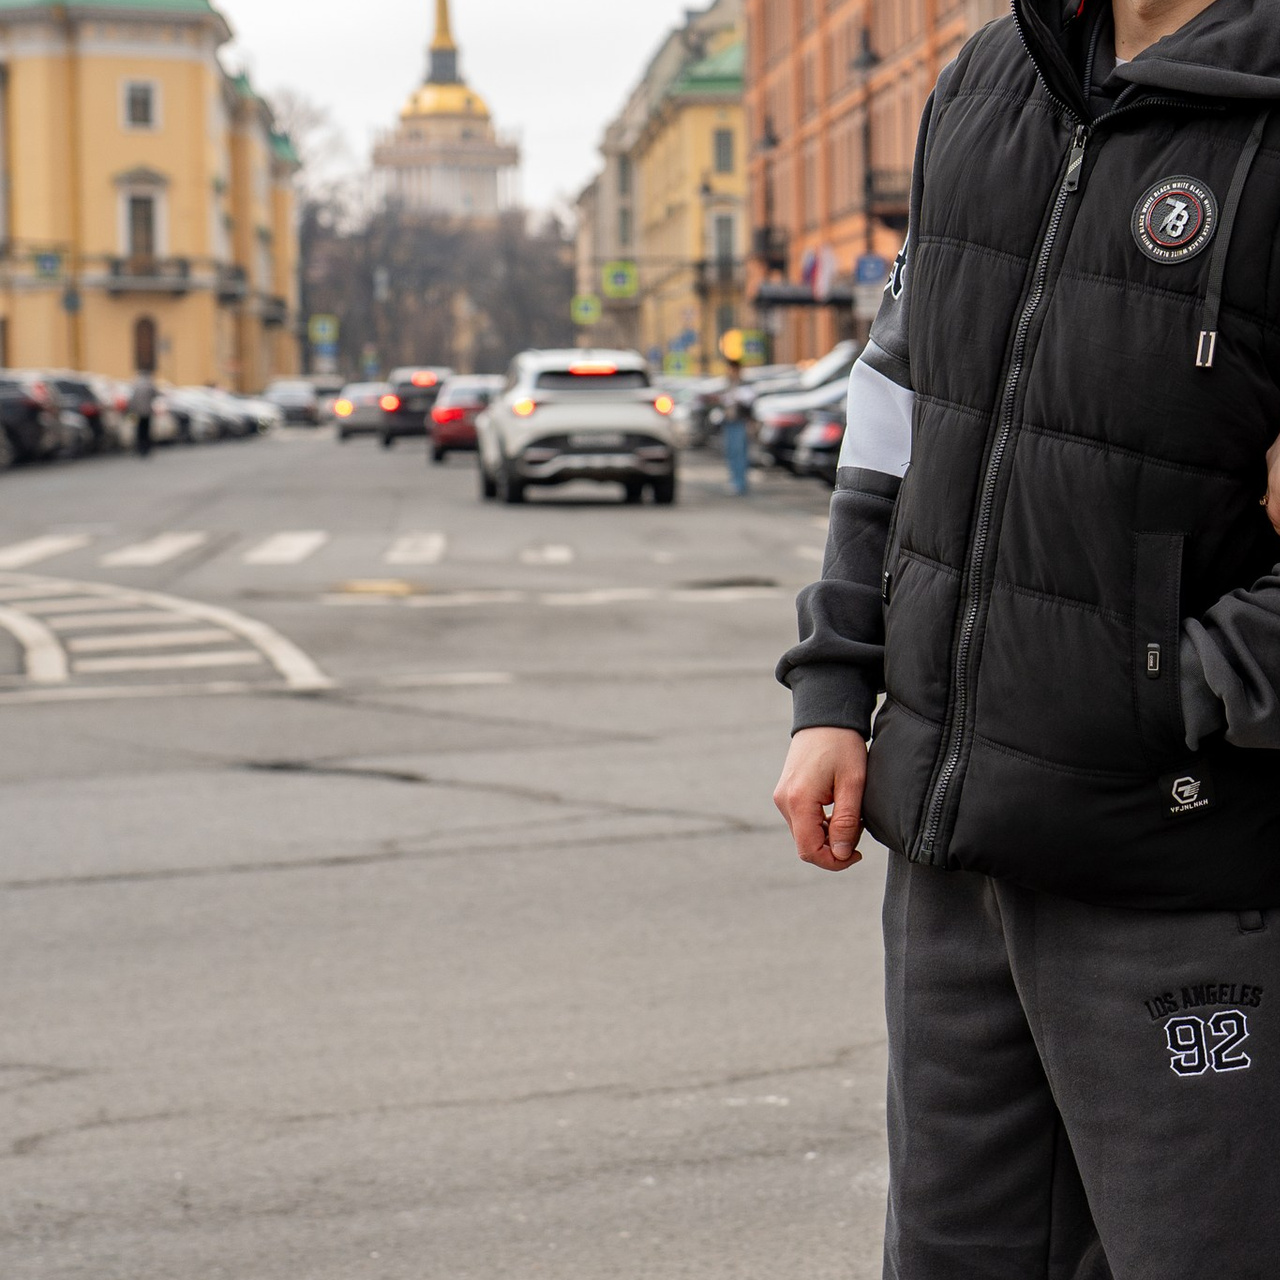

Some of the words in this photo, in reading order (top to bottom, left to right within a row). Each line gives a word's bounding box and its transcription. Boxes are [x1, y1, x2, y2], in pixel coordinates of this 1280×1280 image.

[1153, 184, 1171, 198] BLACK
[1189, 184, 1206, 200] BLACK
[1159, 197, 1190, 238] 78
[1145, 993, 1179, 1021] LOS
[1181, 984, 1262, 1009] ANGELES
[1164, 1010, 1252, 1077] 92
